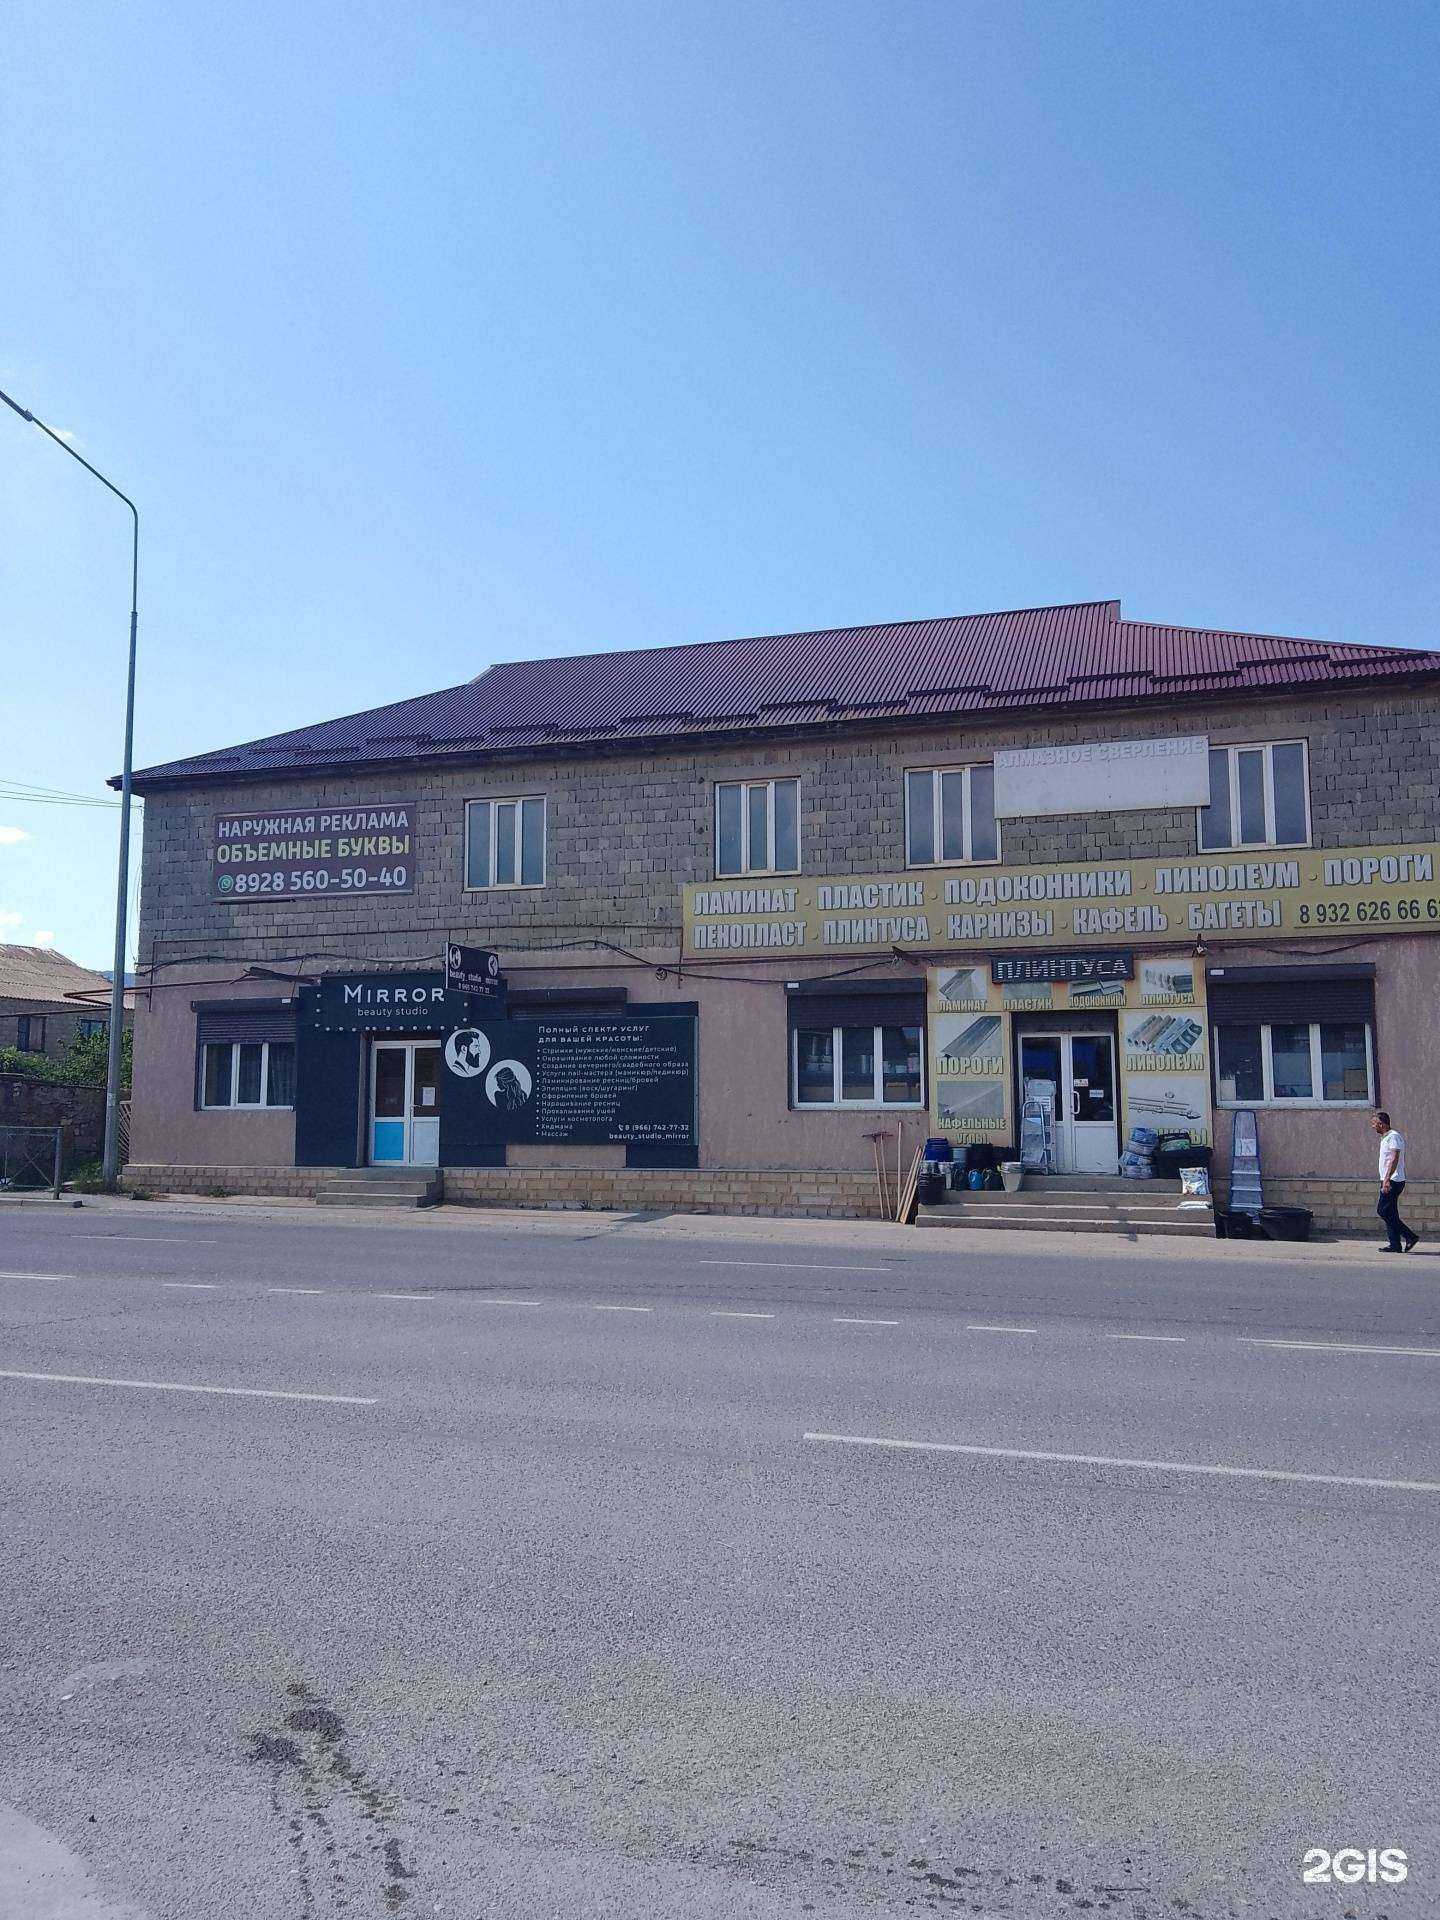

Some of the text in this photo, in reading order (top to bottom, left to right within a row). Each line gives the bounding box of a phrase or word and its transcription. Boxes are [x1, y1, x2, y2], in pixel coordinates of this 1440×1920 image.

[218, 810, 409, 838] НАРУЖНАЯ РЕКЛАМА
[216, 834, 410, 864] ОБЪЕМНЫЕ БУКВЫ
[234, 865, 407, 893] 8928 560-50-40
[694, 853, 1433, 916] ЛАМИНАТ ПЛАСТИК ПОДОКОННИКИ ЛИНОЛЕУМ ПОРОГИ
[1299, 898, 1440, 924] 8 932 626 66 6
[694, 900, 1283, 949] ПЕНОПЛАСТ ПЛИНТУСА КАРНИЗЫ КАФЕЛЬ БАГЕТЫ
[996, 957, 1130, 979] ПЛИНТУСА
[343, 984, 445, 1004] MIRROR
[1068, 993, 1127, 1009] ПОДОКОННИКИ
[1141, 992, 1195, 1005] ПЛИНТУСА
[357, 1006, 428, 1018] beauty studio
[938, 999, 988, 1012] ЛАМИНАТ
[1003, 997, 1054, 1011] ПЛАСТИК
[936, 1056, 1004, 1075] ПОРОГИ
[1125, 1053, 1205, 1072] ЛИНОЛЕУМ
[938, 1117, 1007, 1131] КАФЕЛЬНЫЕ
